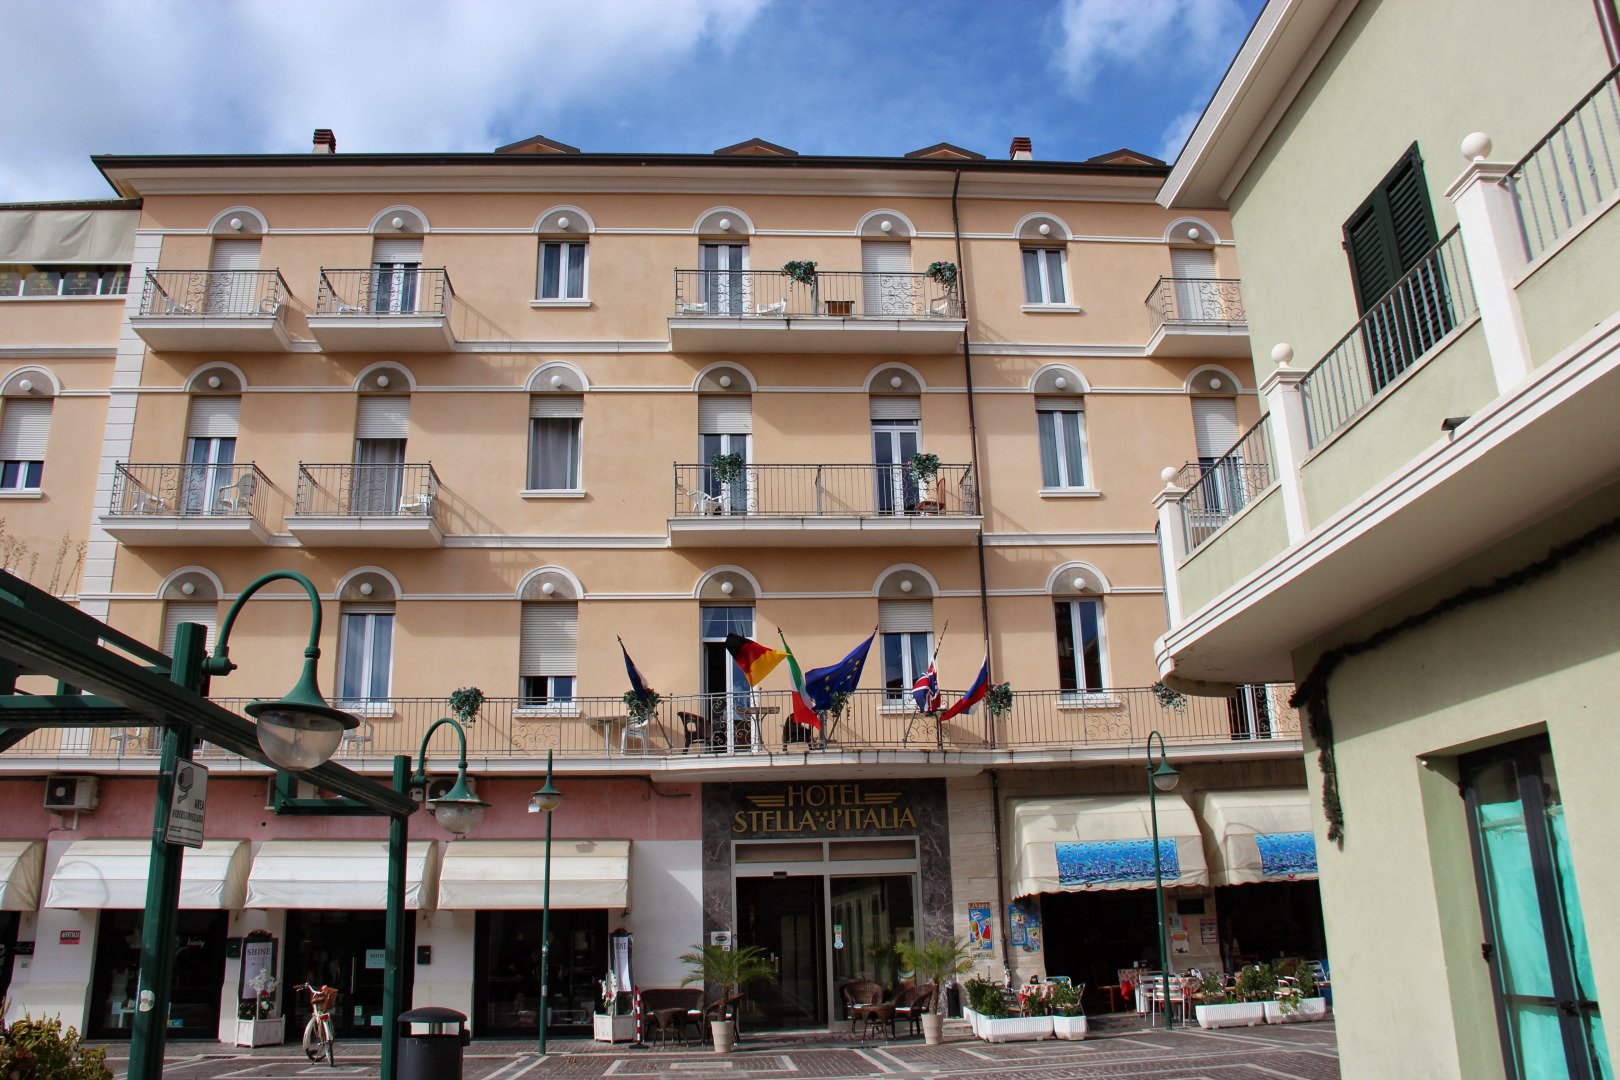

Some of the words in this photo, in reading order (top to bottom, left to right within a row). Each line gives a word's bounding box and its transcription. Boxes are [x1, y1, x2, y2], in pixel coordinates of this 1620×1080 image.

[788, 784, 864, 806] HOTEL
[733, 809, 817, 833] STELLA
[825, 807, 917, 831] d'ITALIA
[247, 948, 271, 956] SHINE
